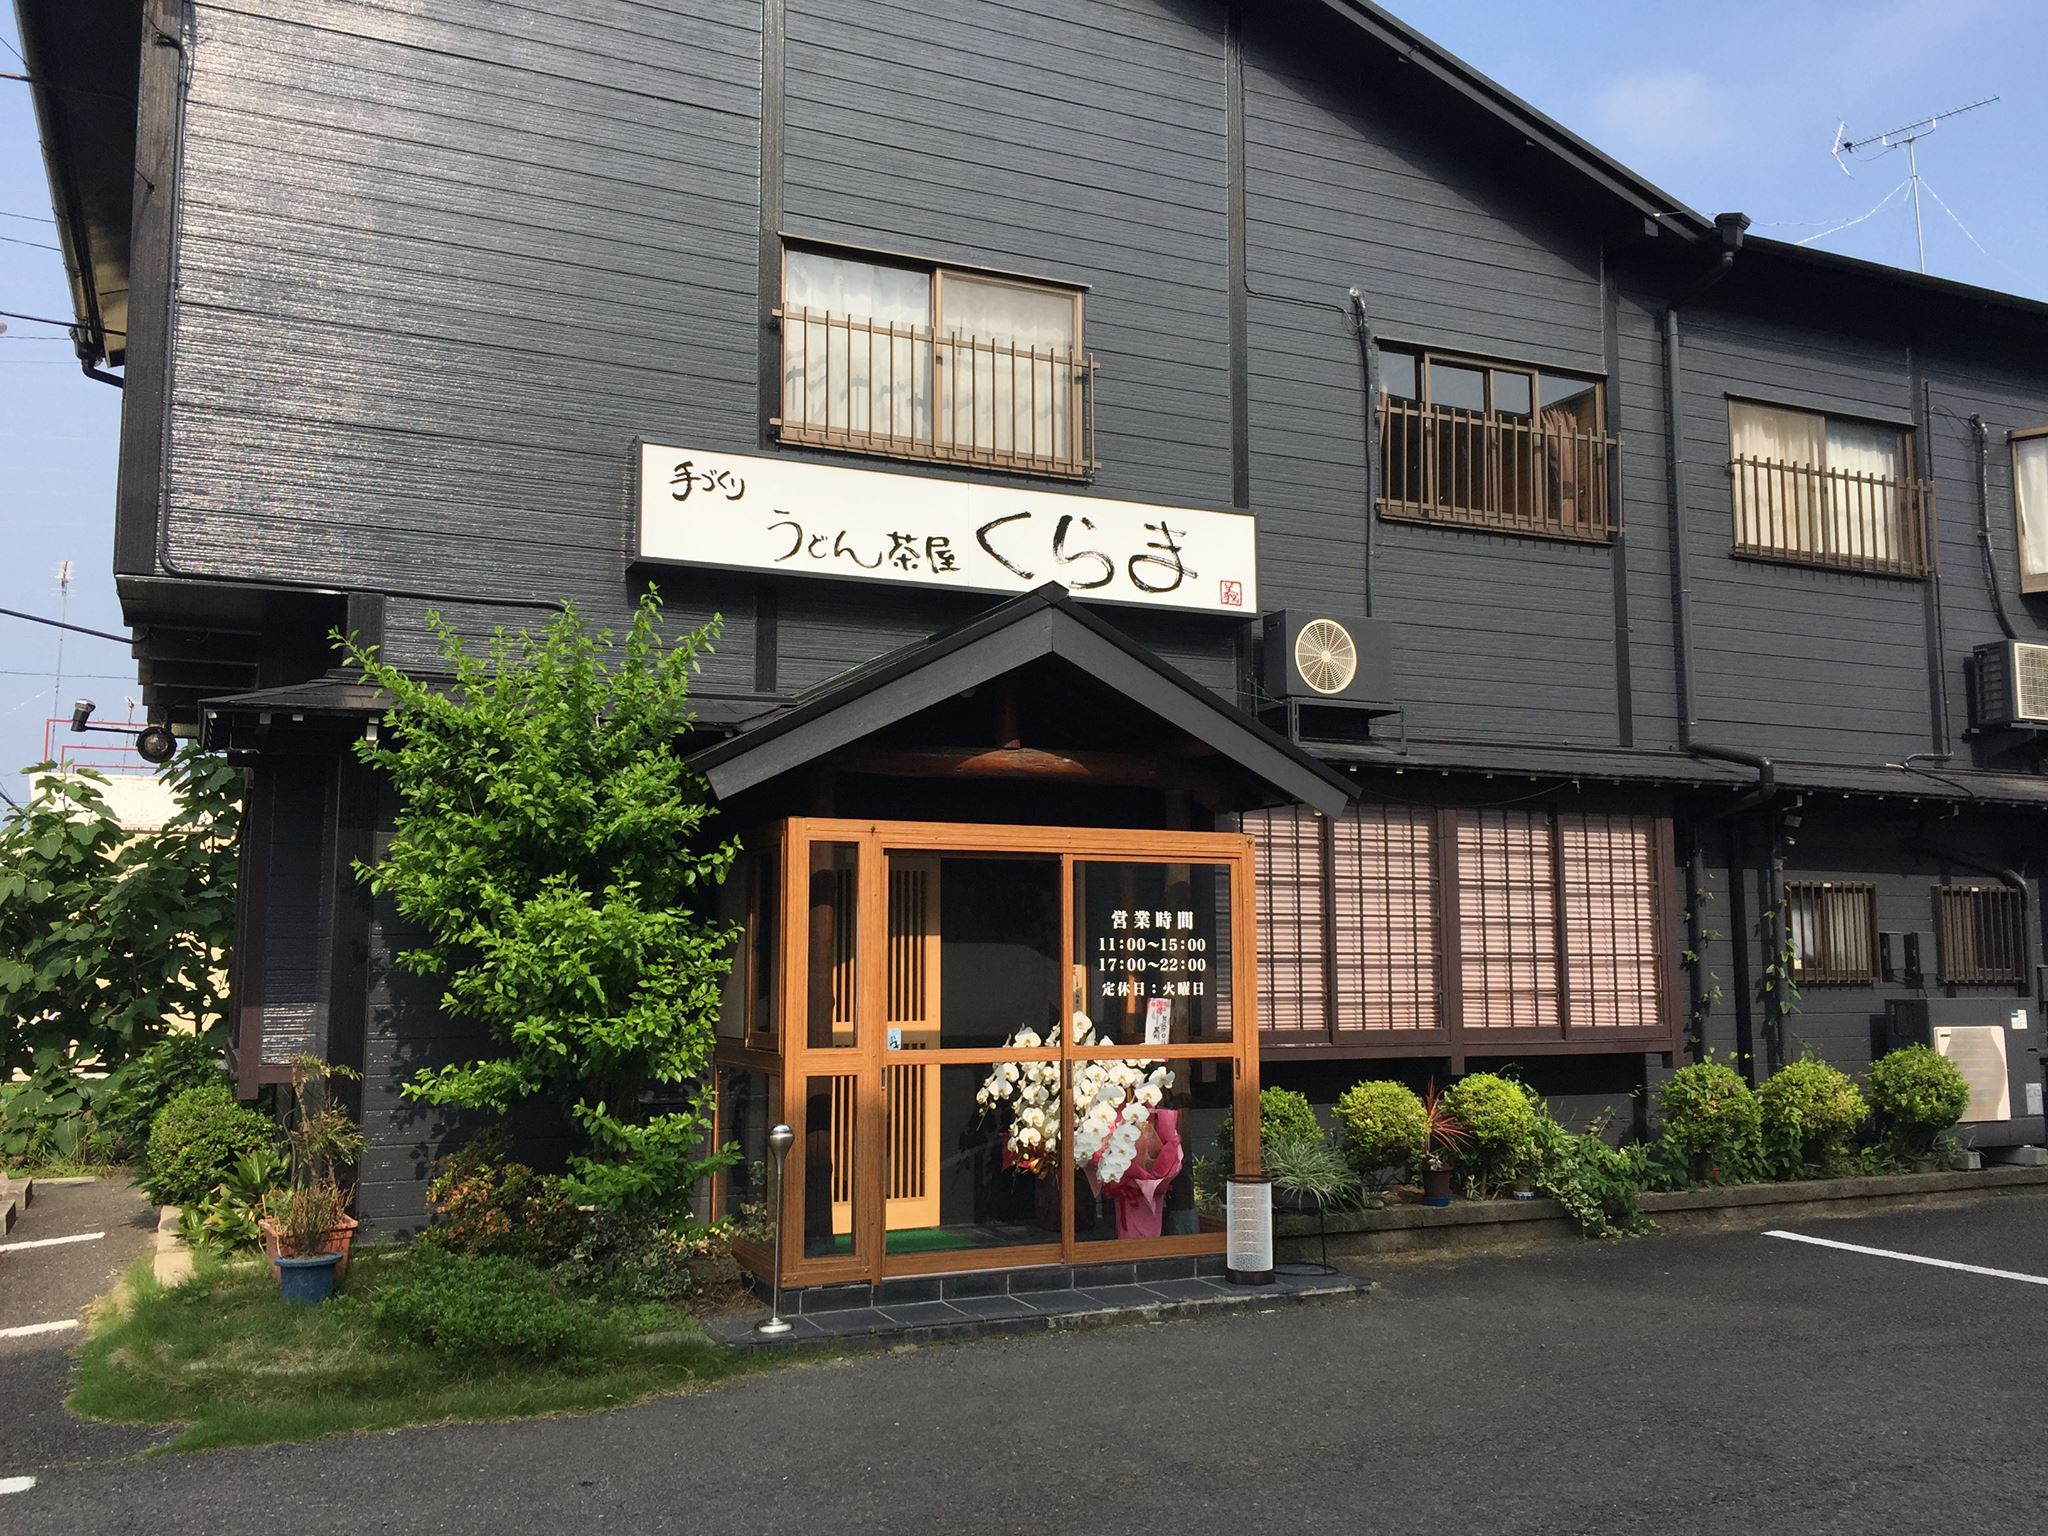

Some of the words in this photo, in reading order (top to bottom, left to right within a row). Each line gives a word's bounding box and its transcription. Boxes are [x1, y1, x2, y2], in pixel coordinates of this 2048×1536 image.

[669, 460, 745, 502] 手づくり
[767, 508, 961, 574] うどん茶屋
[975, 511, 1198, 594] くらま
[1111, 909, 1194, 931] 営業時間
